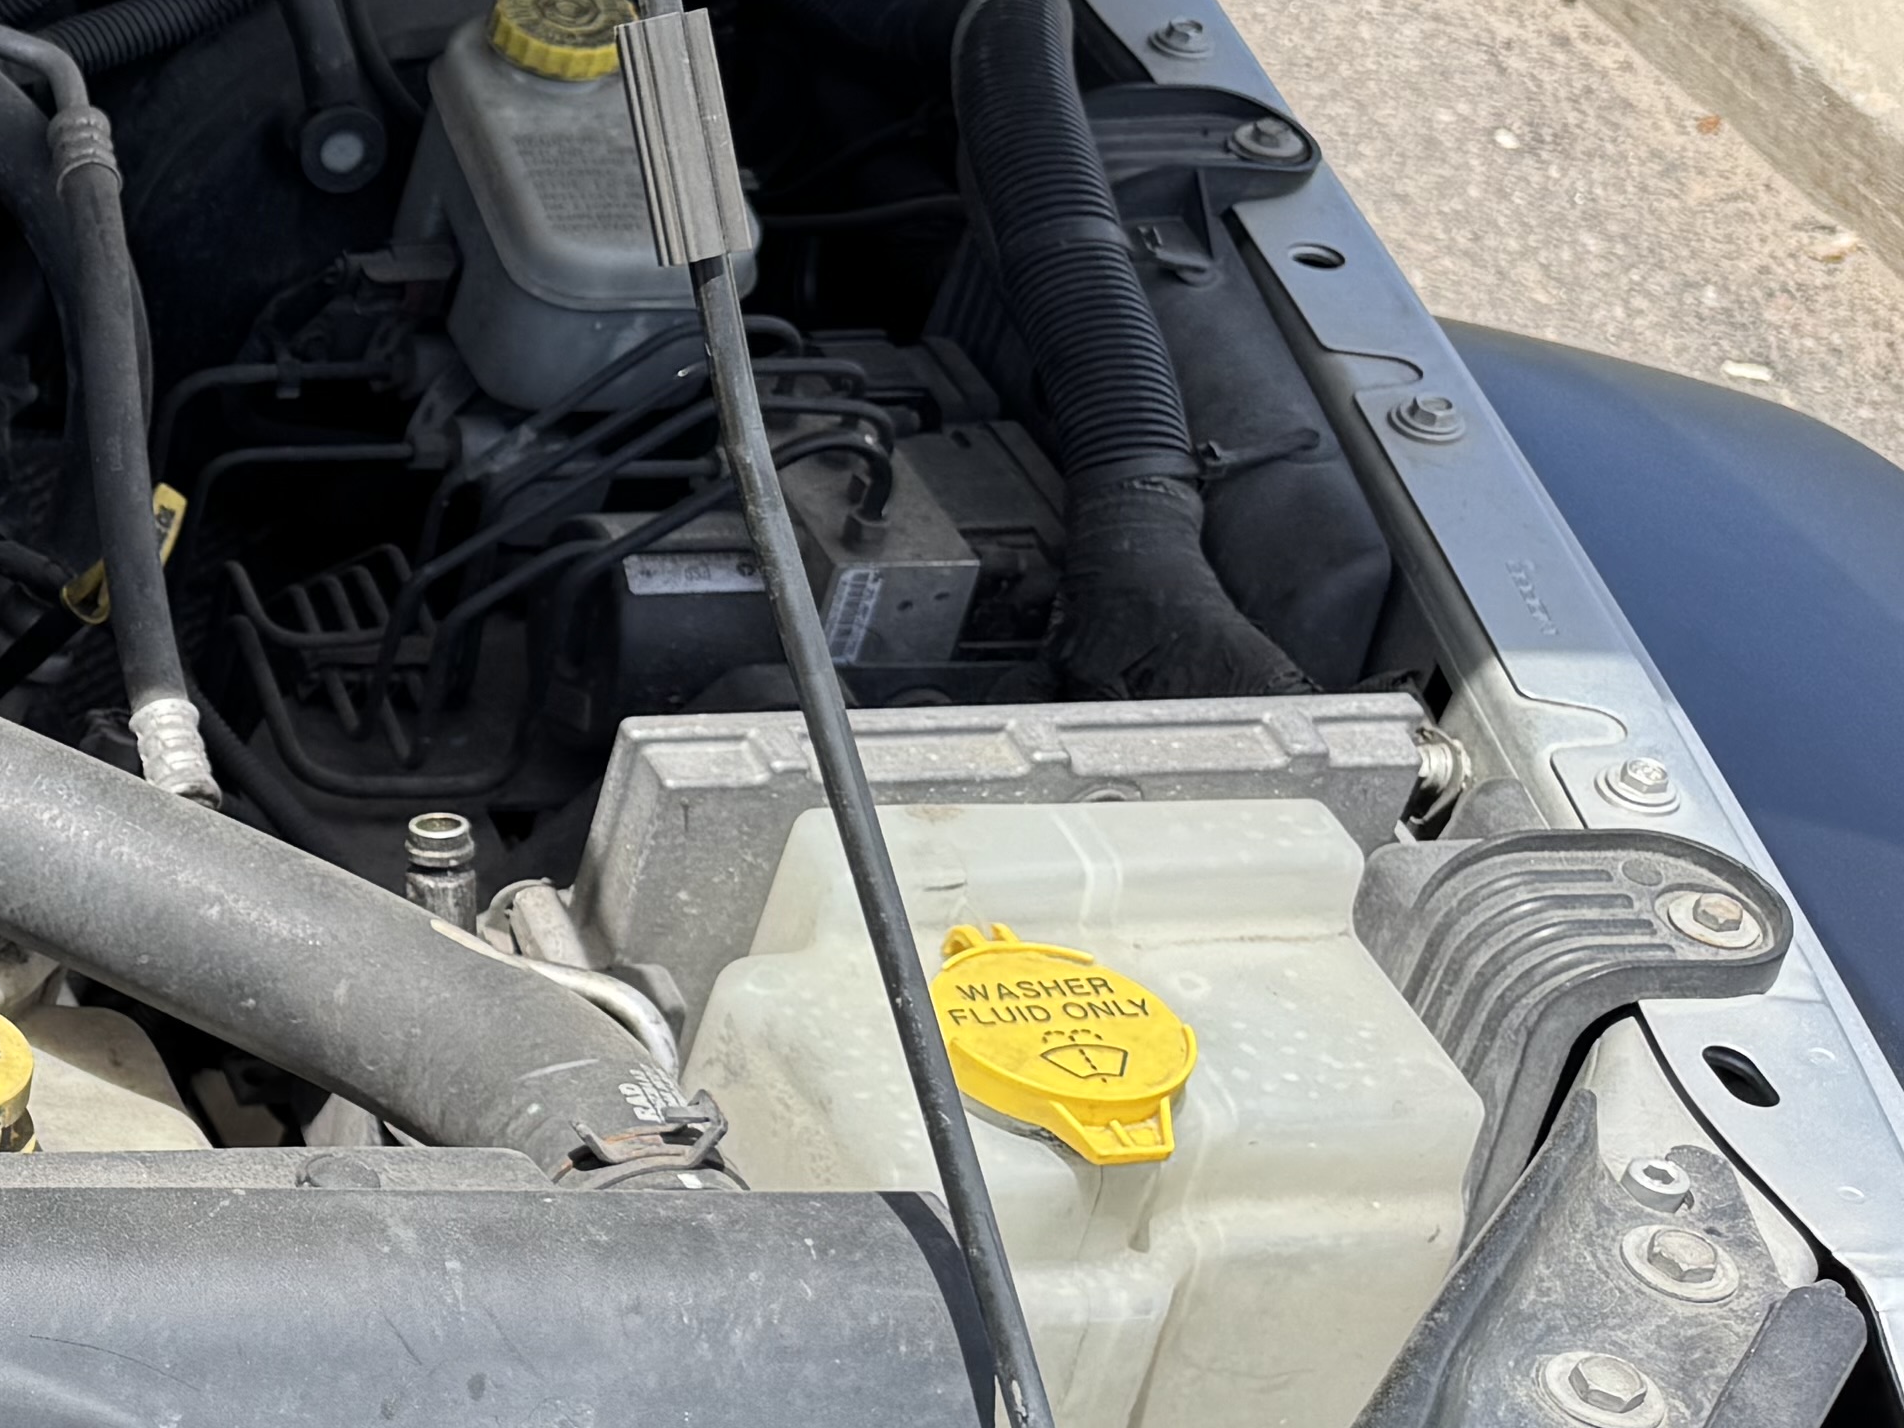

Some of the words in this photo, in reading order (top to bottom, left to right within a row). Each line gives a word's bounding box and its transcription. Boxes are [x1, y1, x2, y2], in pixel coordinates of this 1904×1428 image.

[955, 975, 1115, 1003] WASHER
[947, 1001, 1053, 1027] FLUID
[1063, 997, 1151, 1022] ONLY
[617, 1081, 665, 1124] RAD
